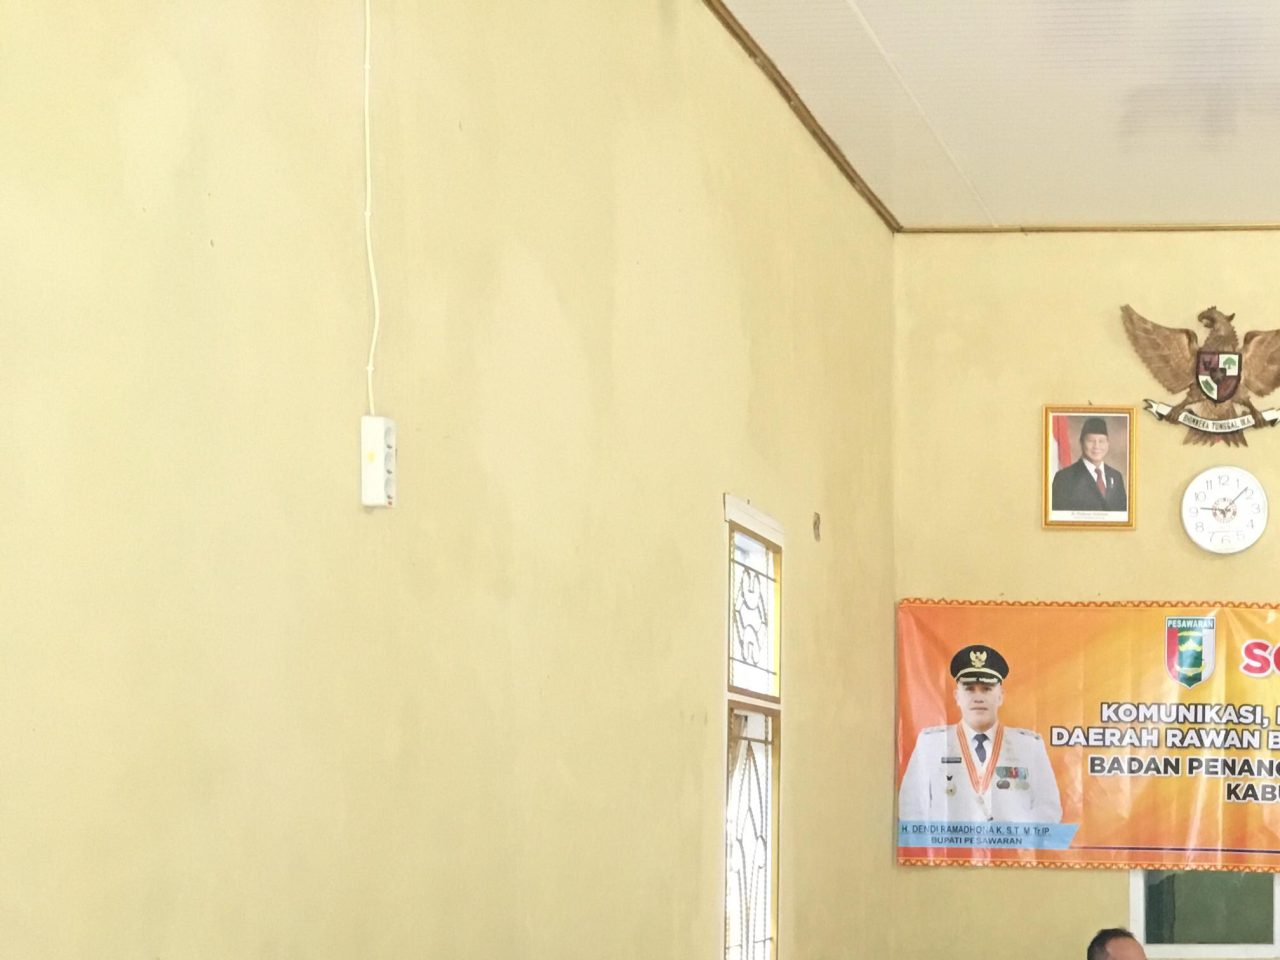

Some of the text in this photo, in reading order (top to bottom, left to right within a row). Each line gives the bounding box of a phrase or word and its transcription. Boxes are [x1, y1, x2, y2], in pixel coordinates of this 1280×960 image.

[1101, 702, 1270, 728] KOMUNIKASI,
[1050, 726, 1160, 748] DAERAH
[1165, 728, 1262, 750] RAWAN
[1089, 755, 1181, 775] BADAN
[912, 824, 939, 833] DENDI
[931, 836, 1023, 845] BUPATI PESAWARAN
